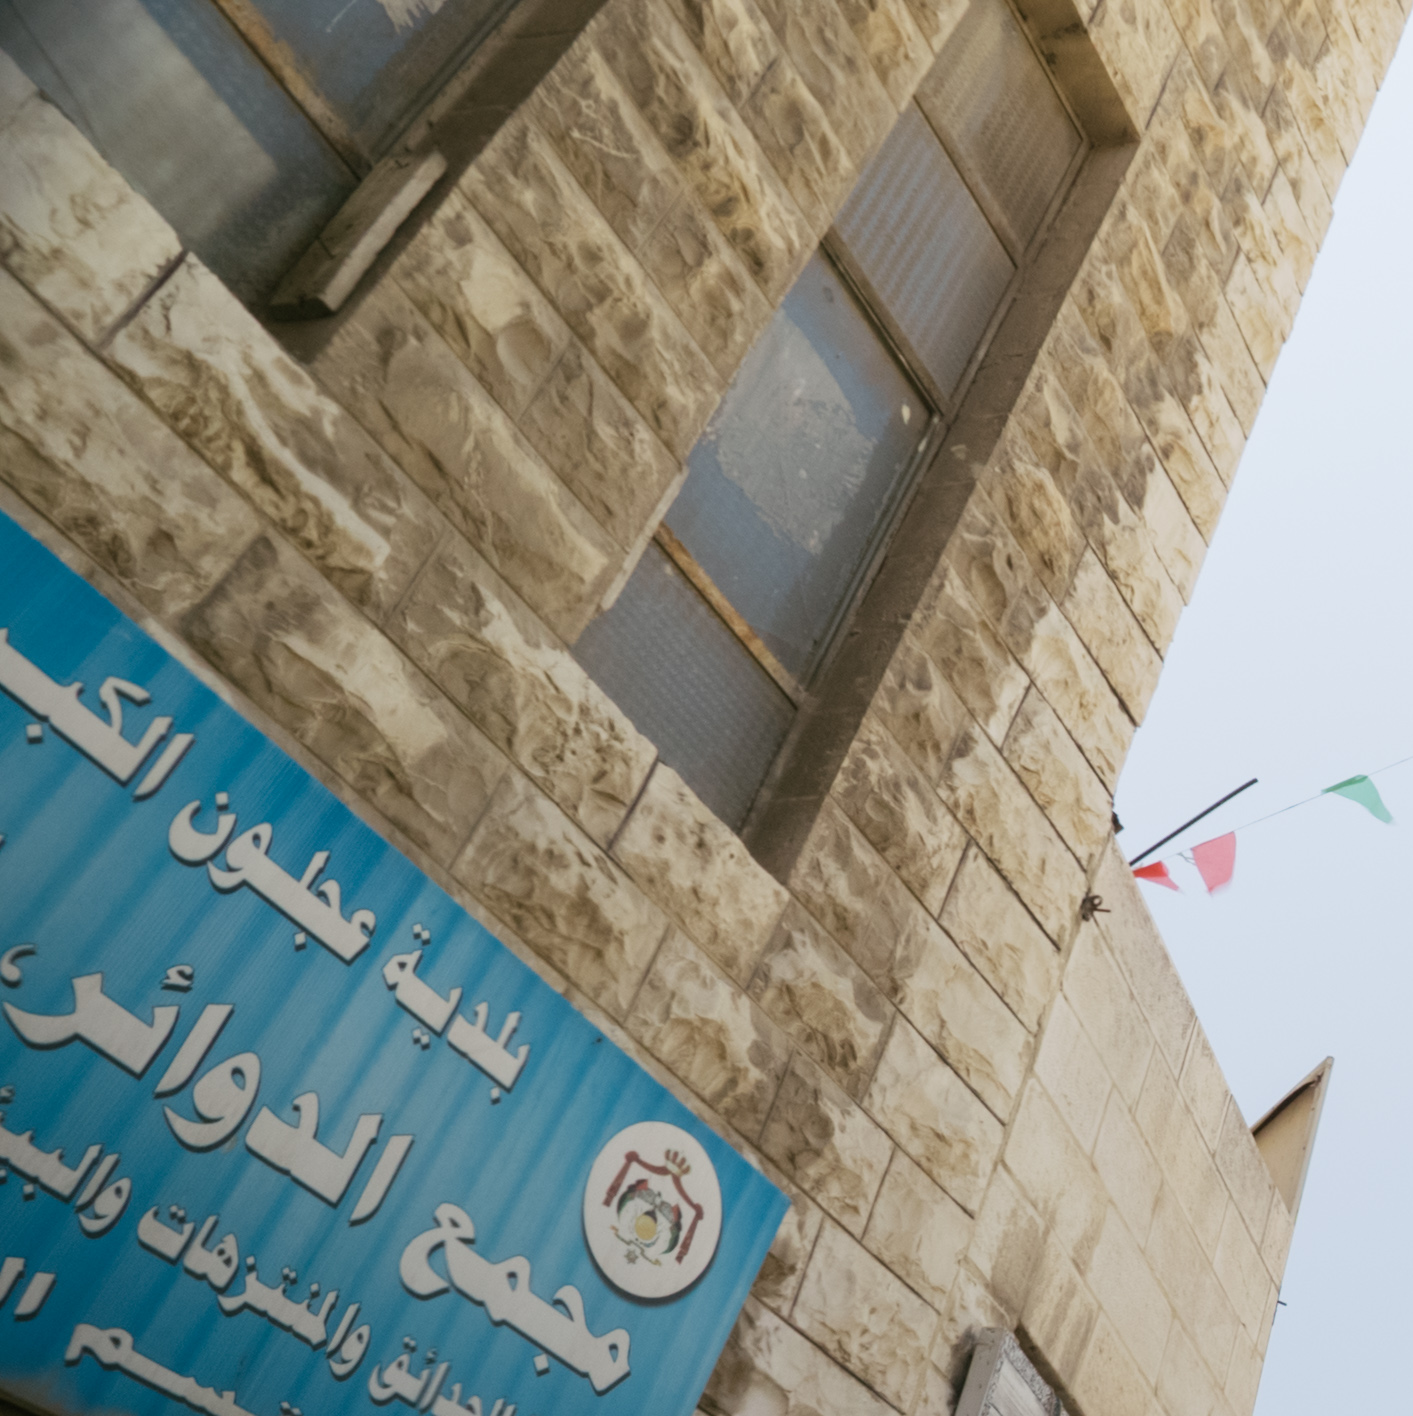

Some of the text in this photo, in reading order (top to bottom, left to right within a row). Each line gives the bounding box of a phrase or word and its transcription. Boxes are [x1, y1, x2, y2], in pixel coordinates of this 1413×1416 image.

[168, 790, 376, 968] عجلون
[382, 922, 530, 1104] بلدية
[3, 964, 632, 1398] مجمع الدوائر
[137, 1203, 372, 1382] والمنتزهات
